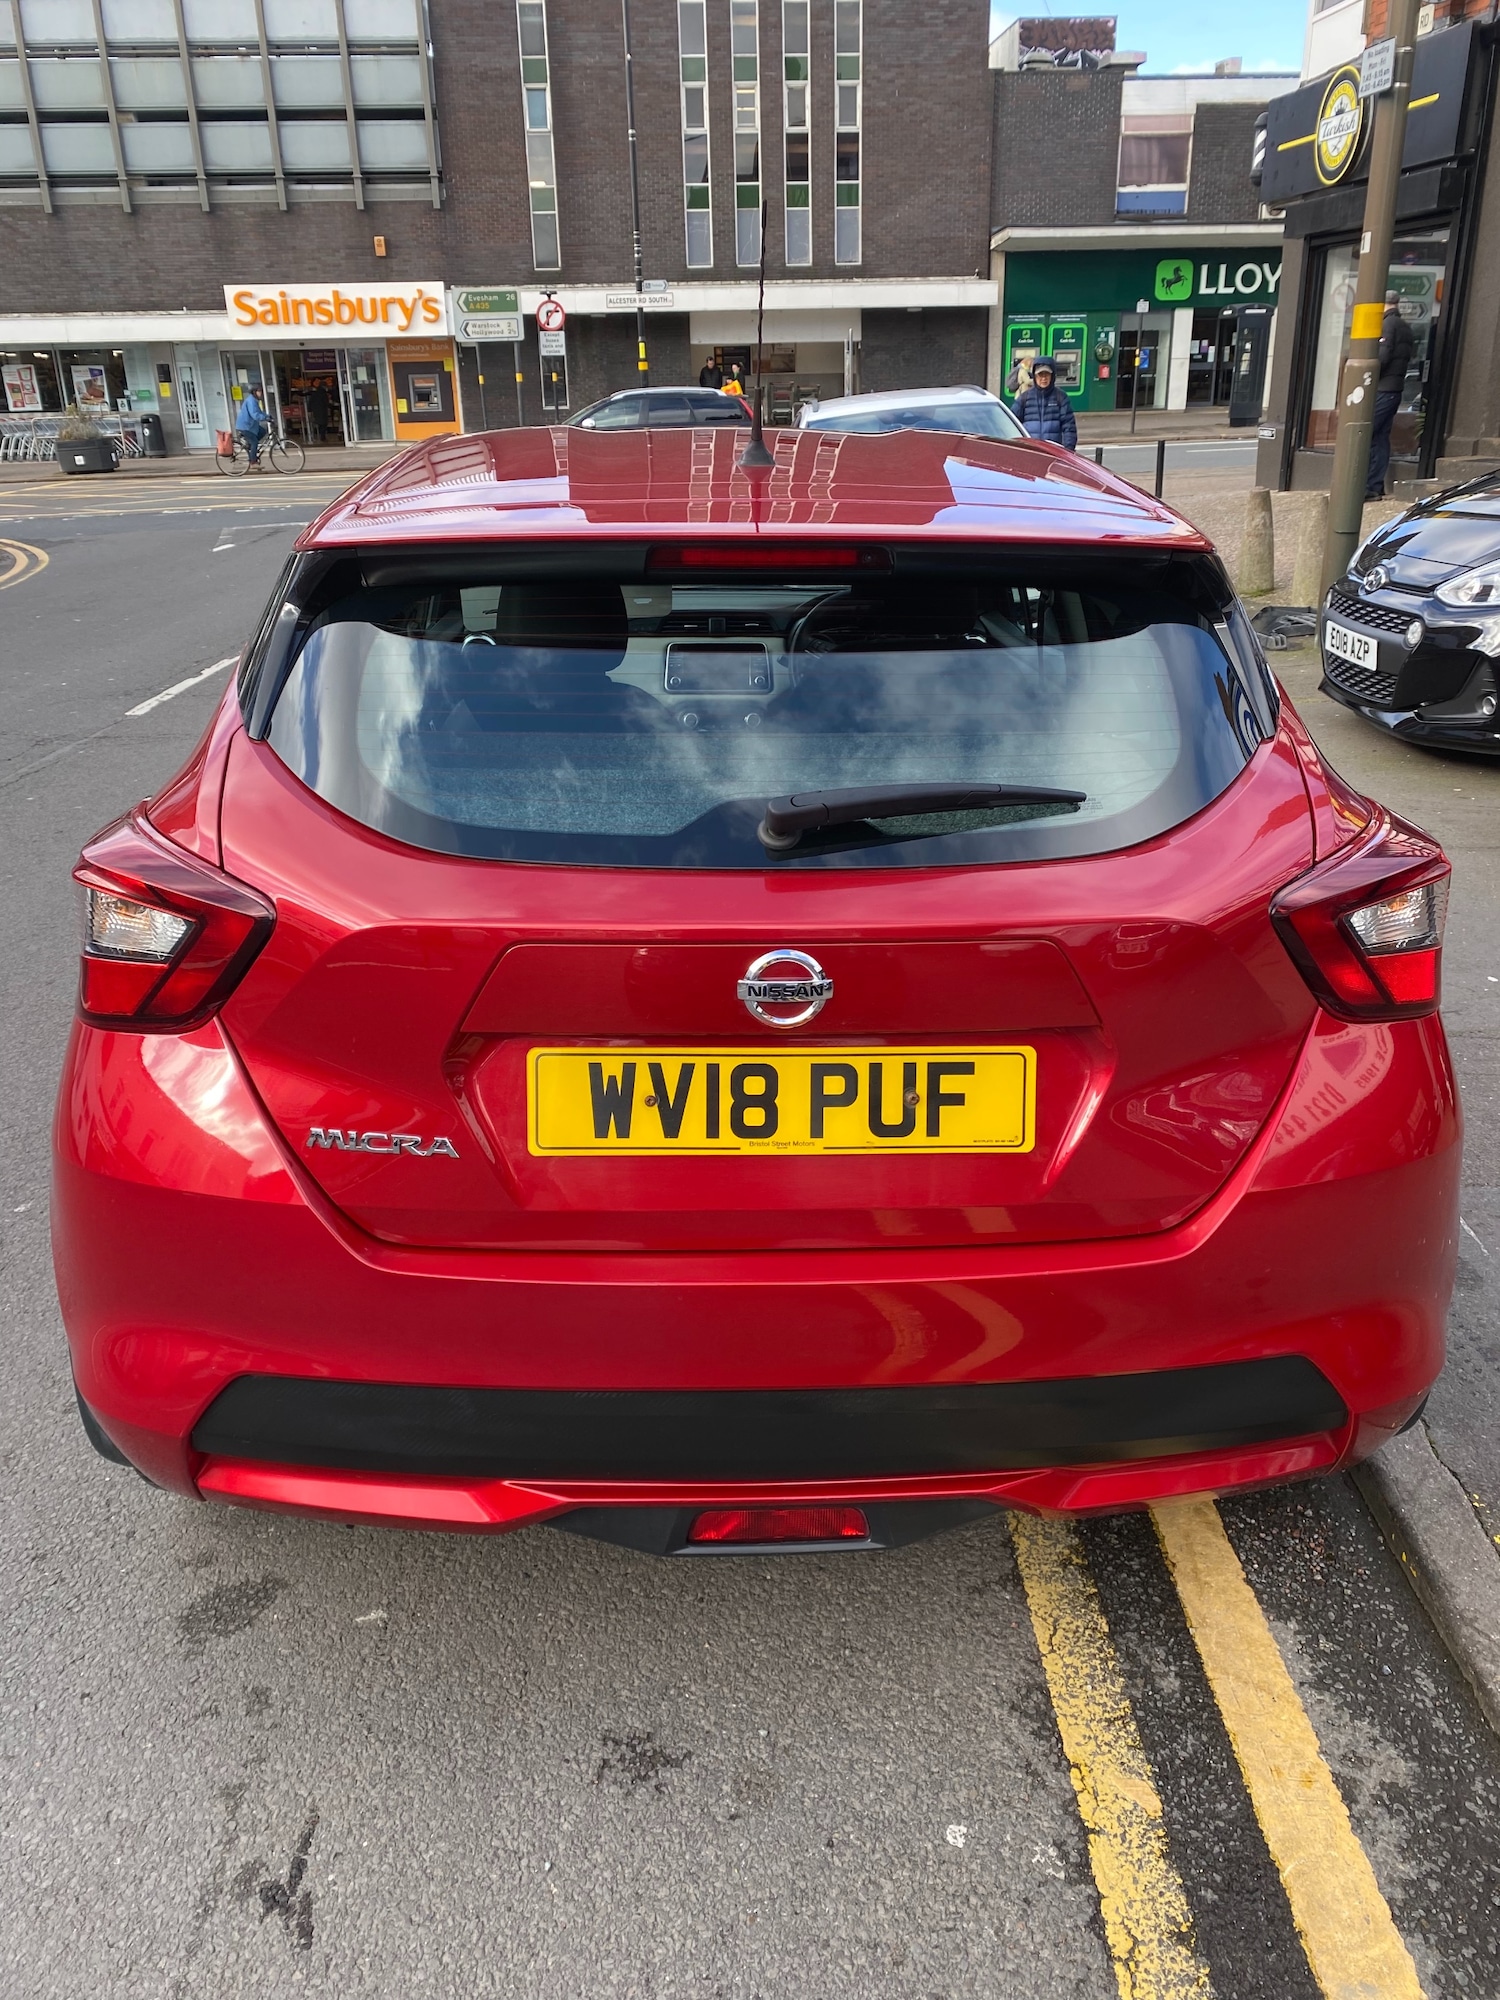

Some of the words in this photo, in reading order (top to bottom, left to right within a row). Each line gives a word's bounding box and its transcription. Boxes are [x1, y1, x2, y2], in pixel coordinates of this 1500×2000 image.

[1420, 13, 1430, 29] RD
[1321, 111, 1357, 138] Turkish
[468, 293, 499, 301] Evesham
[505, 293, 516, 301] 26
[609, 297, 637, 305] ALCESTER
[233, 288, 441, 331] Sainsbury's
[390, 343, 430, 352] Sainsbury's
[1350, 636, 1370, 662] AZP
[747, 985, 824, 997] NISSAN
[588, 1062, 779, 1139] WV18
[809, 1061, 976, 1139] PUF
[306, 1127, 460, 1158] MICRA
